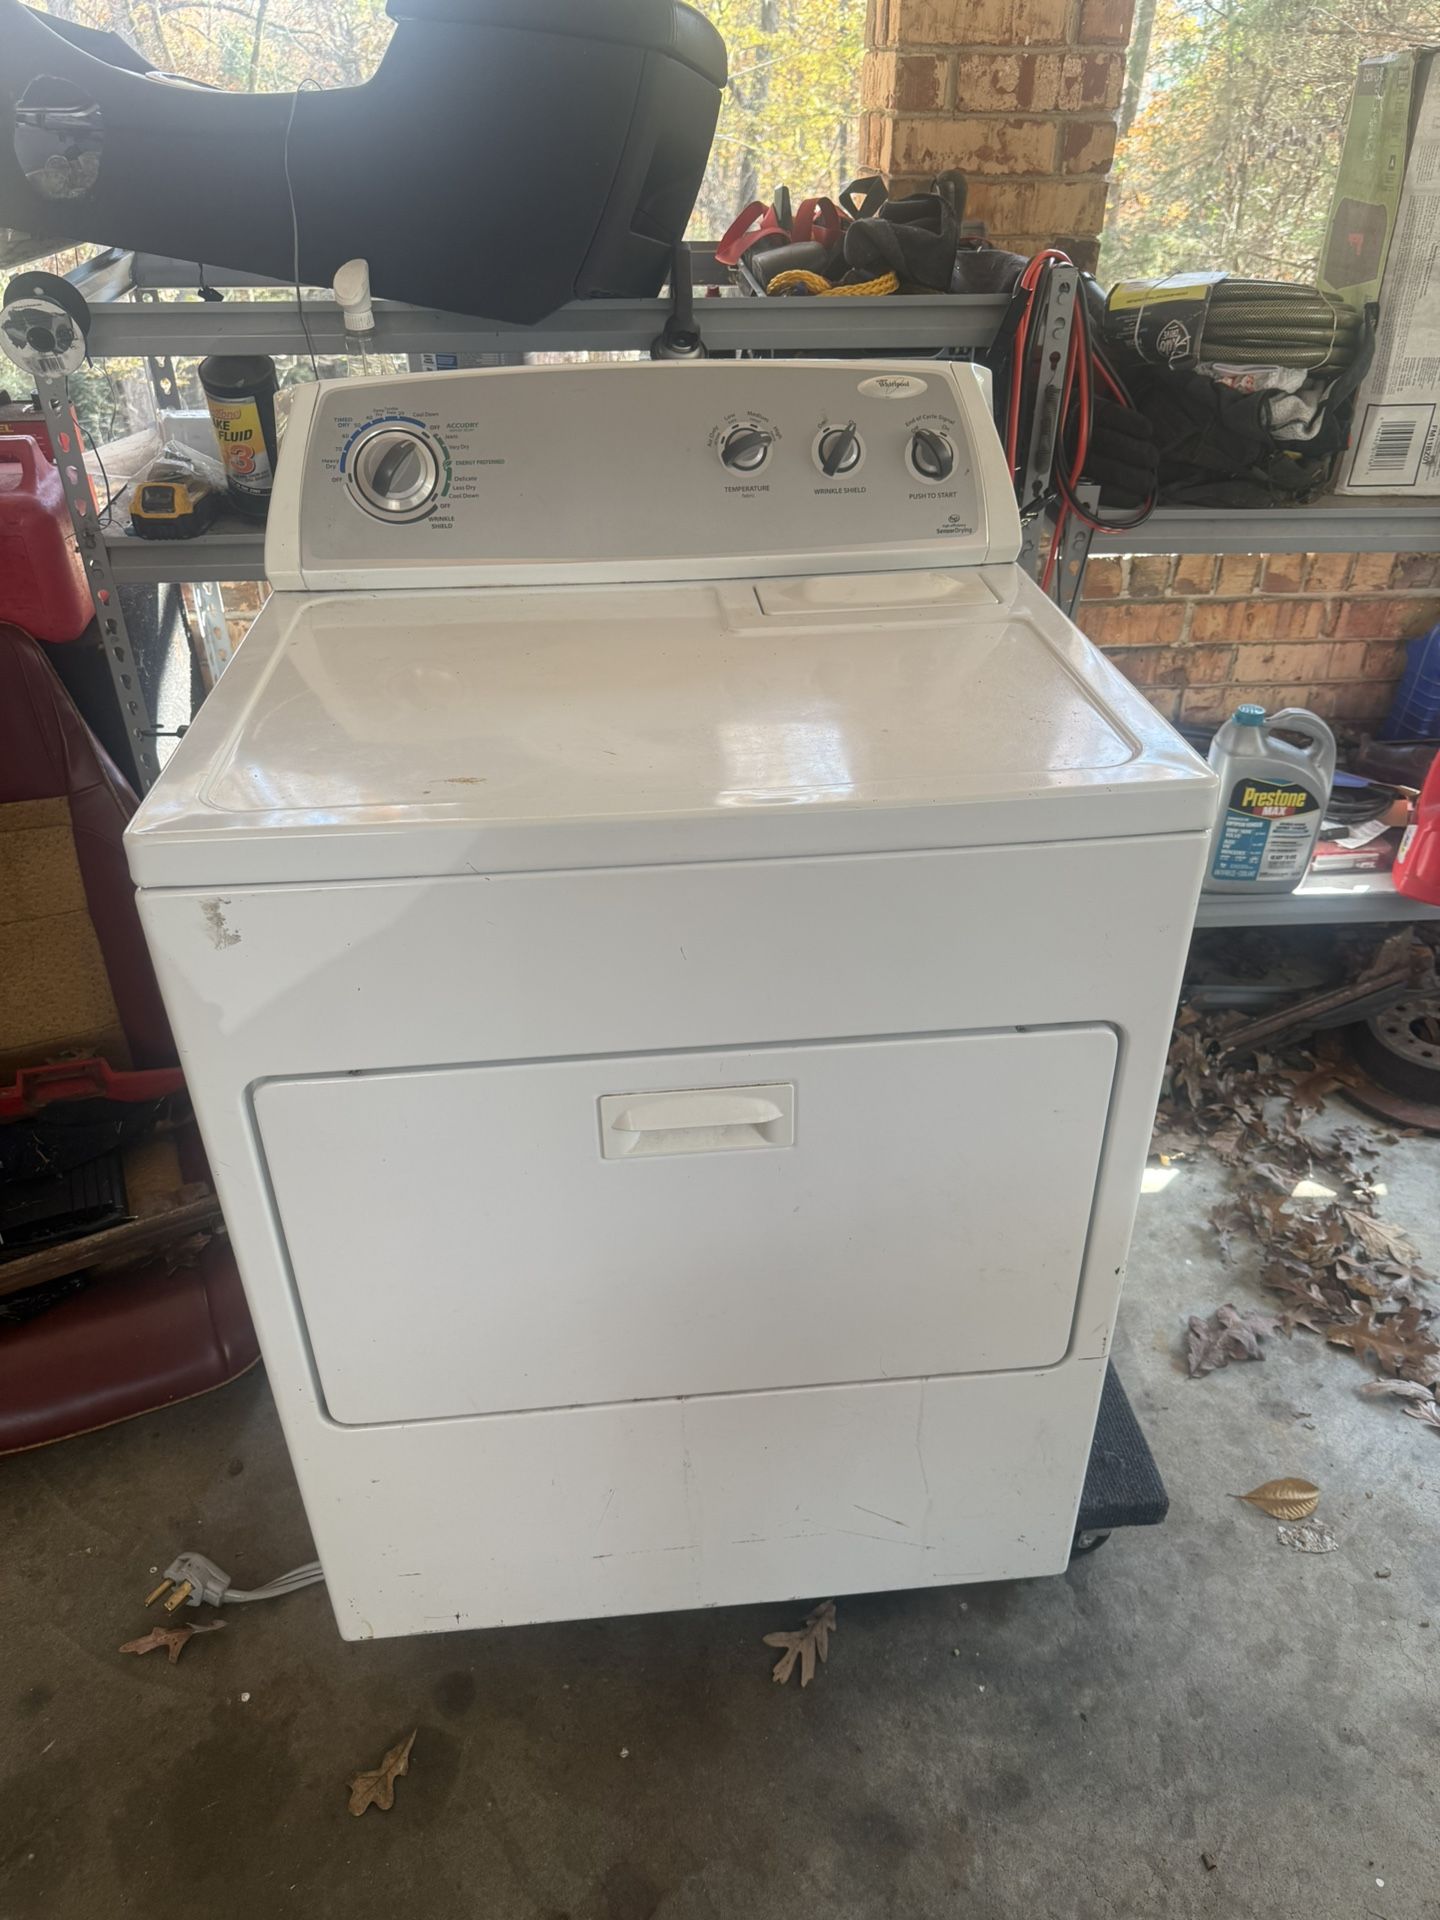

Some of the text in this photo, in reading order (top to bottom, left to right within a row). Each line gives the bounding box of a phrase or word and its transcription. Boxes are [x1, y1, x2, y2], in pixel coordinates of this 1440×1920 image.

[218, 429, 253, 442] FLUID
[230, 444, 256, 475] 3
[724, 485, 770, 493] TEMPERATURE
[814, 486, 867, 495] WRINKLE SHIELD
[937, 491, 957, 499] START
[1242, 787, 1307, 808] Prestone
[1262, 807, 1286, 816] MAX
